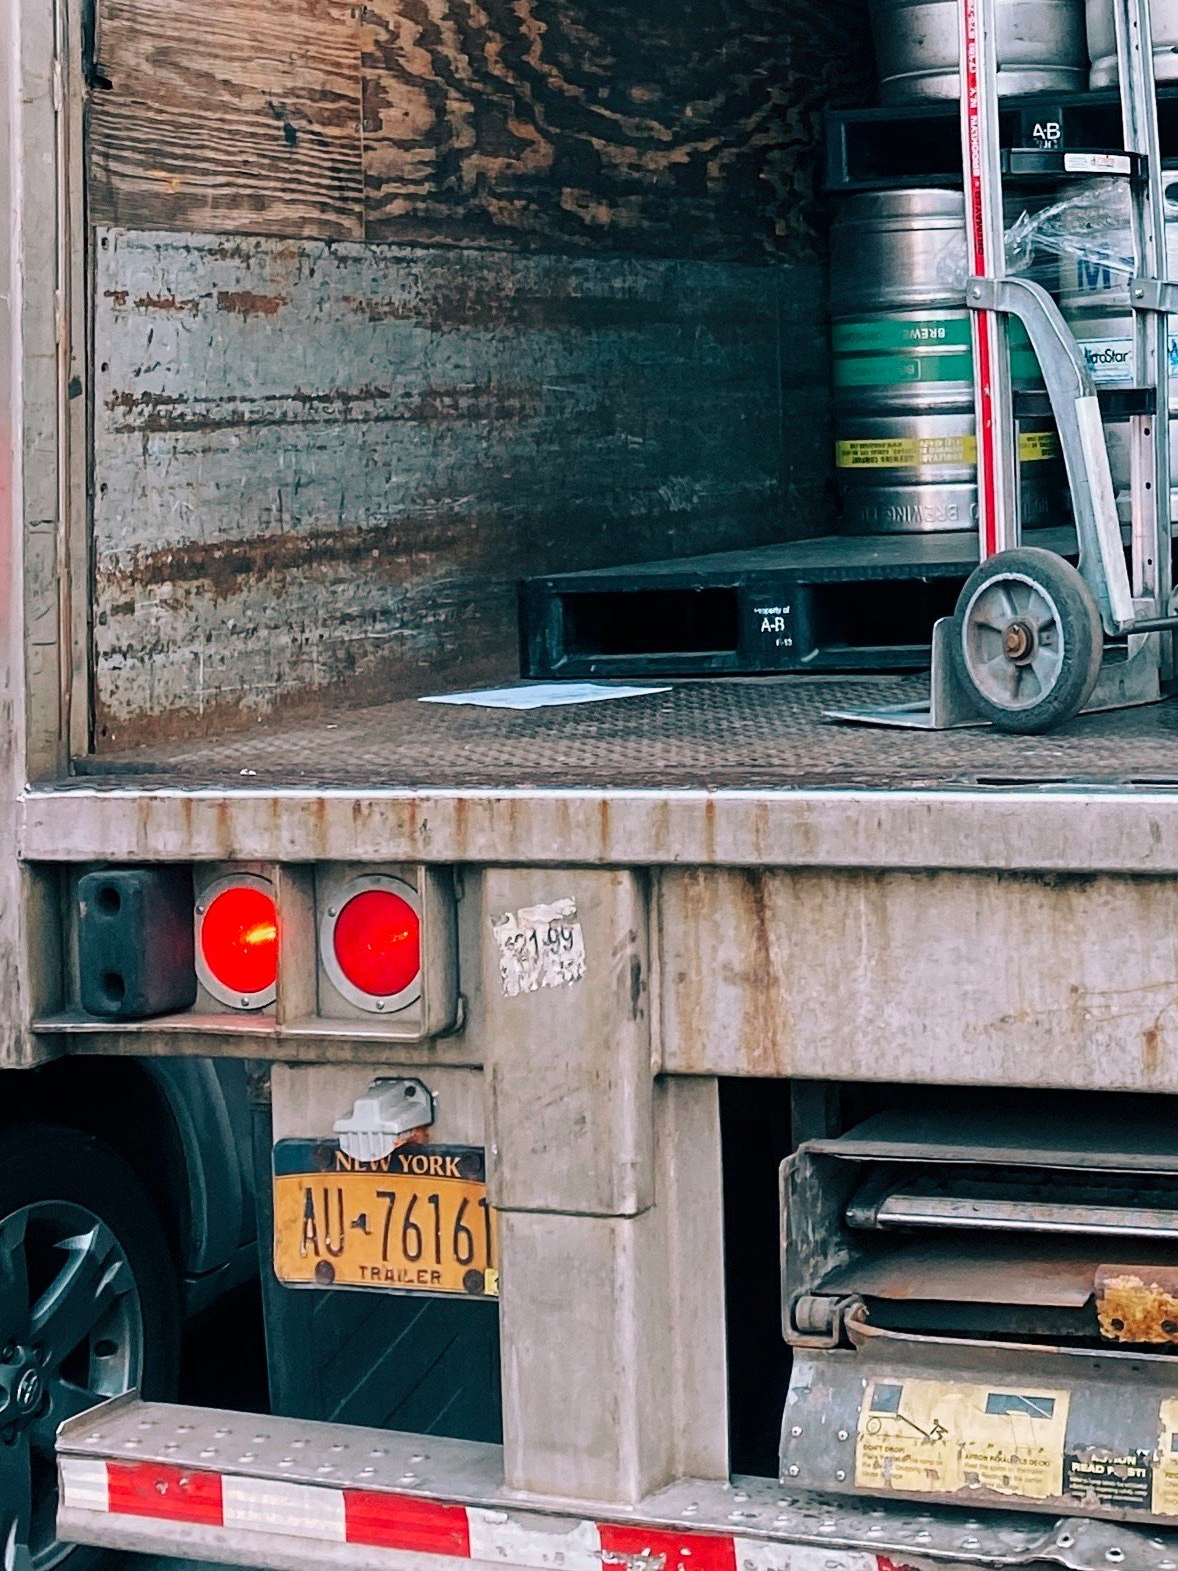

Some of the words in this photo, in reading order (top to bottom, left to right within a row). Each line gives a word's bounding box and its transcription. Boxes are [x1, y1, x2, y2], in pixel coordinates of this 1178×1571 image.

[970, 115, 981, 177] BROOKLYN
[761, 616, 785, 633] A-B
[398, 1153, 462, 1178] YORK
[301, 1187, 345, 1258] AU
[359, 1265, 443, 1285] TRAILER
[1071, 1461, 1105, 1474] READ
